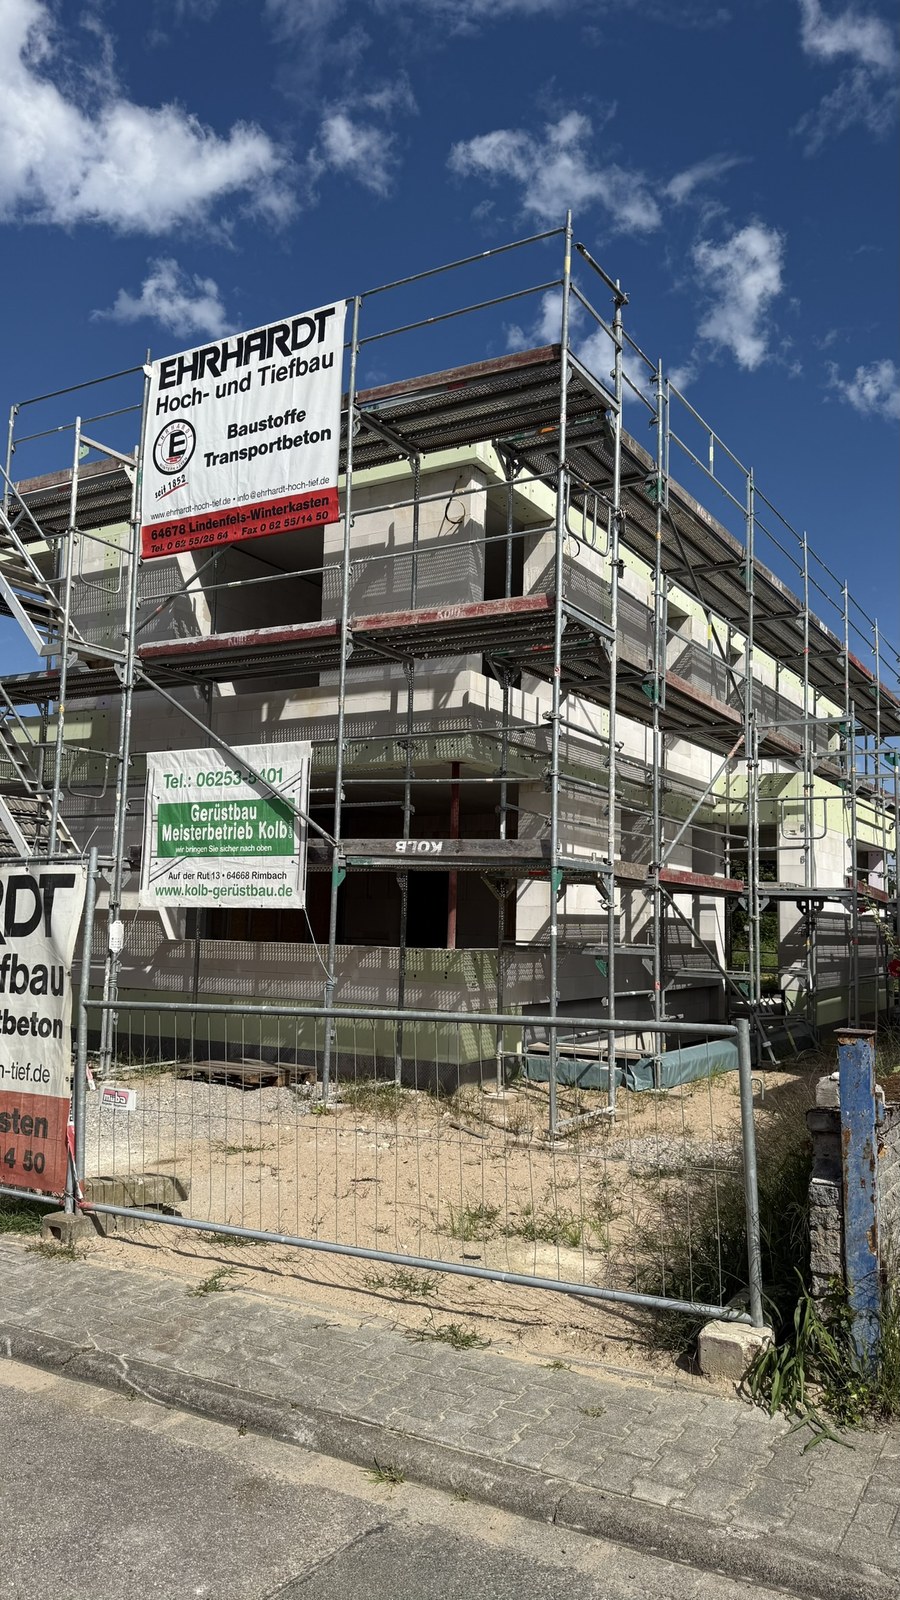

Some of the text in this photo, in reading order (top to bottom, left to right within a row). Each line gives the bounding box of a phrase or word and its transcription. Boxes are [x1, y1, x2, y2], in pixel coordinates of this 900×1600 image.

[158, 307, 336, 391] EHRHARDT
[155, 352, 335, 416] Hoch- und Tiefbau
[226, 407, 307, 440] Baustoffe
[168, 430, 187, 458] E
[203, 428, 332, 468] Transportbeton
[154, 474, 187, 499] seit 1852
[150, 497, 231, 521] www.ehrhardt-hoch-tief.de
[151, 496, 329, 541] 64678 Lindenfels-Winterkasten
[151, 543, 165, 553] Tel.
[166, 541, 173, 550] 0
[188, 533, 215, 546] 55/28
[241, 526, 258, 536] Fax
[260, 523, 267, 532] 0
[284, 513, 313, 528] 55/14
[315, 510, 329, 520] 50
[163, 773, 192, 789] Tel.:
[190, 803, 257, 822] Gerüstbau
[161, 822, 253, 842] Meisterbetrieb
[258, 820, 288, 840] Kolb
[185, 845, 208, 855] bringen
[208, 844, 219, 853] Sie
[220, 844, 239, 853] sicher
[240, 844, 255, 852] nach
[256, 844, 272, 852] oben
[395, 840, 443, 856] KOLB
[168, 871, 287, 880] Auf der Rut 13 64668 Rimbach
[155, 884, 293, 900] www.kolb-gerüstbau.de
[23, 1149, 45, 1175] 50
